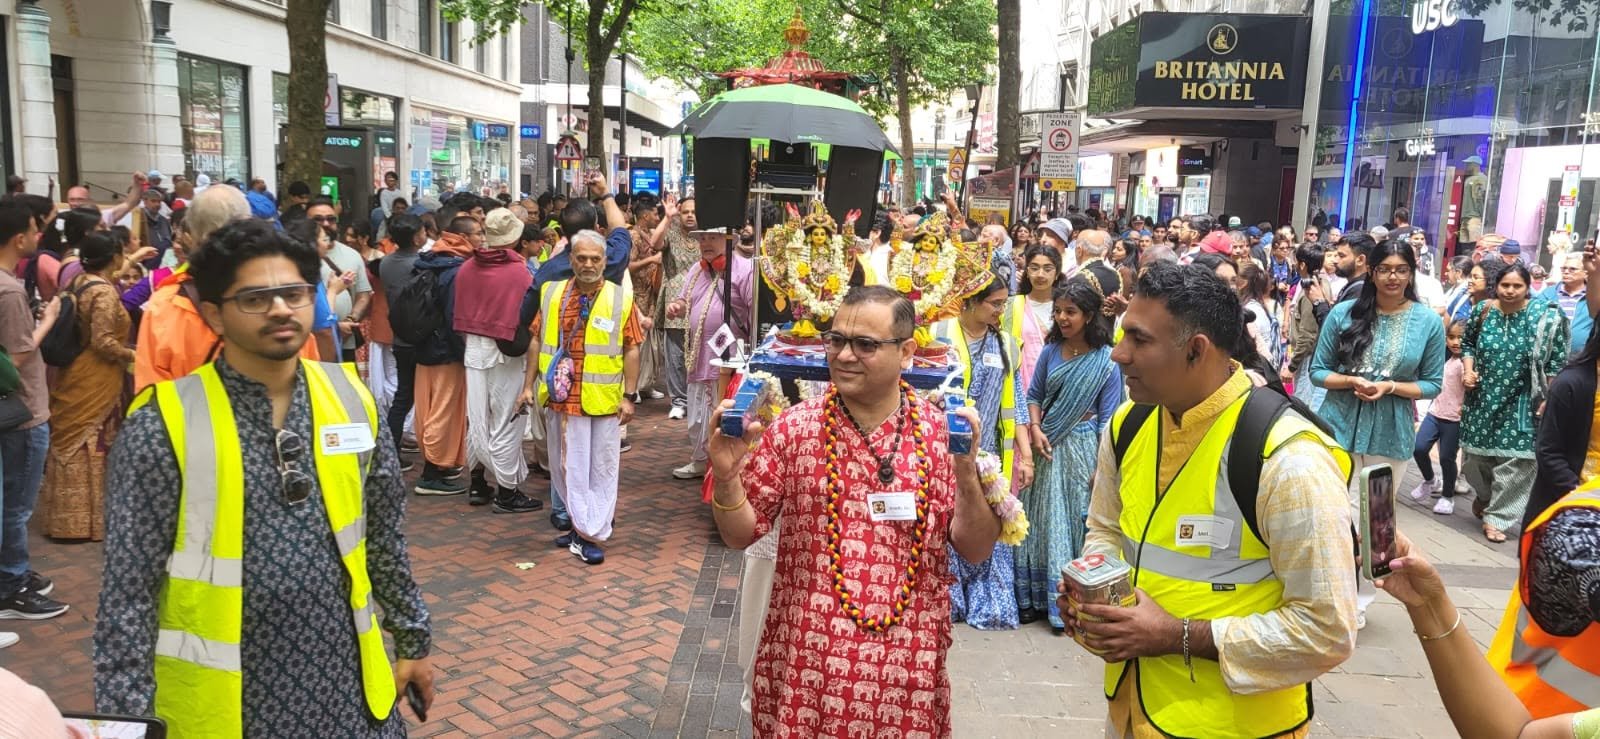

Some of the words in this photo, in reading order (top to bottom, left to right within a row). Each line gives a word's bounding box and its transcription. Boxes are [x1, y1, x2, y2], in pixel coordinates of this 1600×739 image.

[1411, 0, 1458, 35] USC
[1154, 60, 1285, 80] BRITANNIA
[1181, 82, 1255, 101] HOTEL
[325, 137, 350, 146] ATOR
[1405, 138, 1436, 156] GAME
